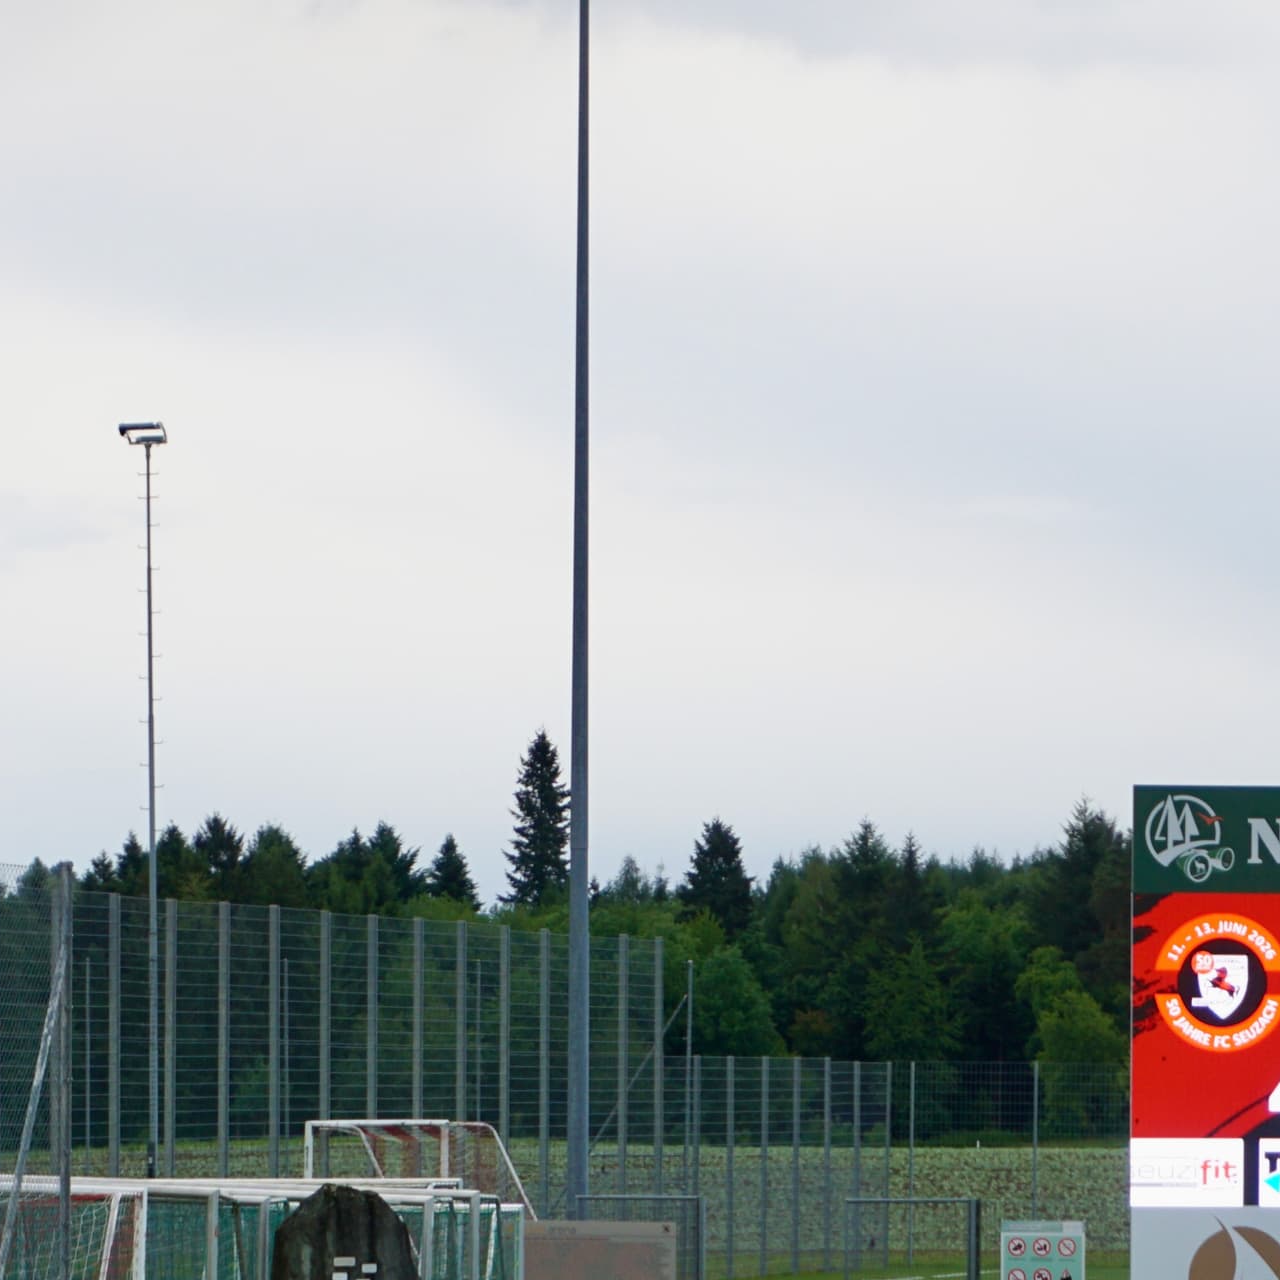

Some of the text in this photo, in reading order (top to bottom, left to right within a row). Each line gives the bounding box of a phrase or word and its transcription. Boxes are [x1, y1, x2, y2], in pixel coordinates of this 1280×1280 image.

[1194, 922, 1216, 938] 13.
[1217, 919, 1248, 936] JUNI
[1247, 929, 1277, 961] 2026
[1165, 998, 1279, 1049] 50 JAHRE FC SEUZACH
